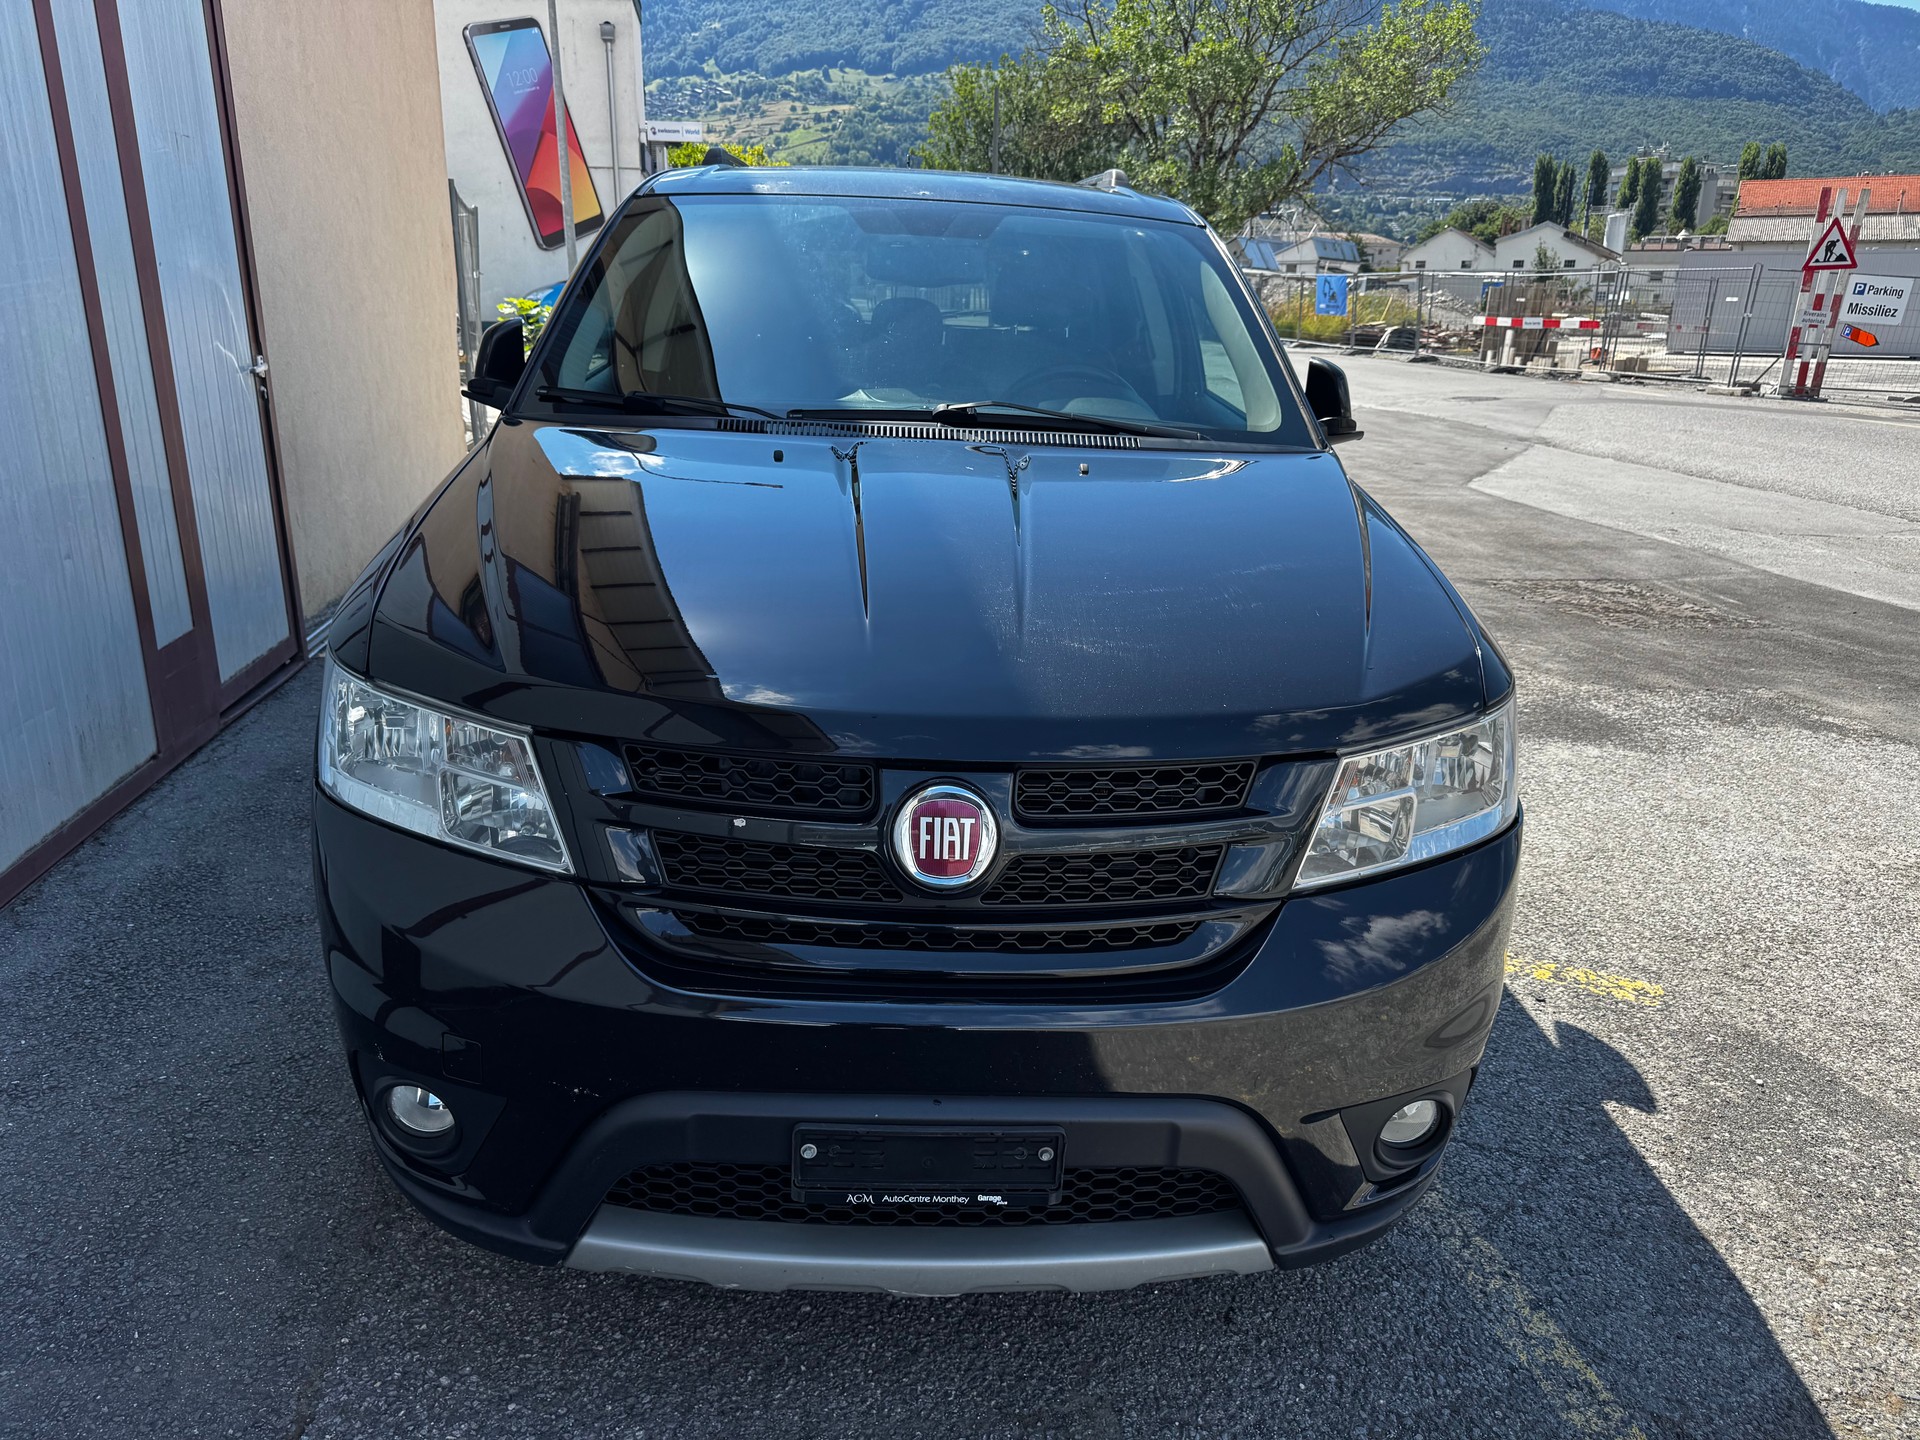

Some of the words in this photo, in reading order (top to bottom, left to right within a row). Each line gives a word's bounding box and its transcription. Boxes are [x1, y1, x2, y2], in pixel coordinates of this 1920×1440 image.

[506, 67, 539, 87] 12:00
[1867, 285, 1904, 300] Parking
[1803, 310, 1827, 318] Riverains
[1847, 302, 1899, 318] Missiliez
[920, 817, 975, 860] FIAT
[846, 1193, 875, 1205] ACM
[881, 1194, 931, 1203] AutoCentre
[932, 1195, 970, 1205] Monthey
[977, 1194, 1002, 1203] Garage
